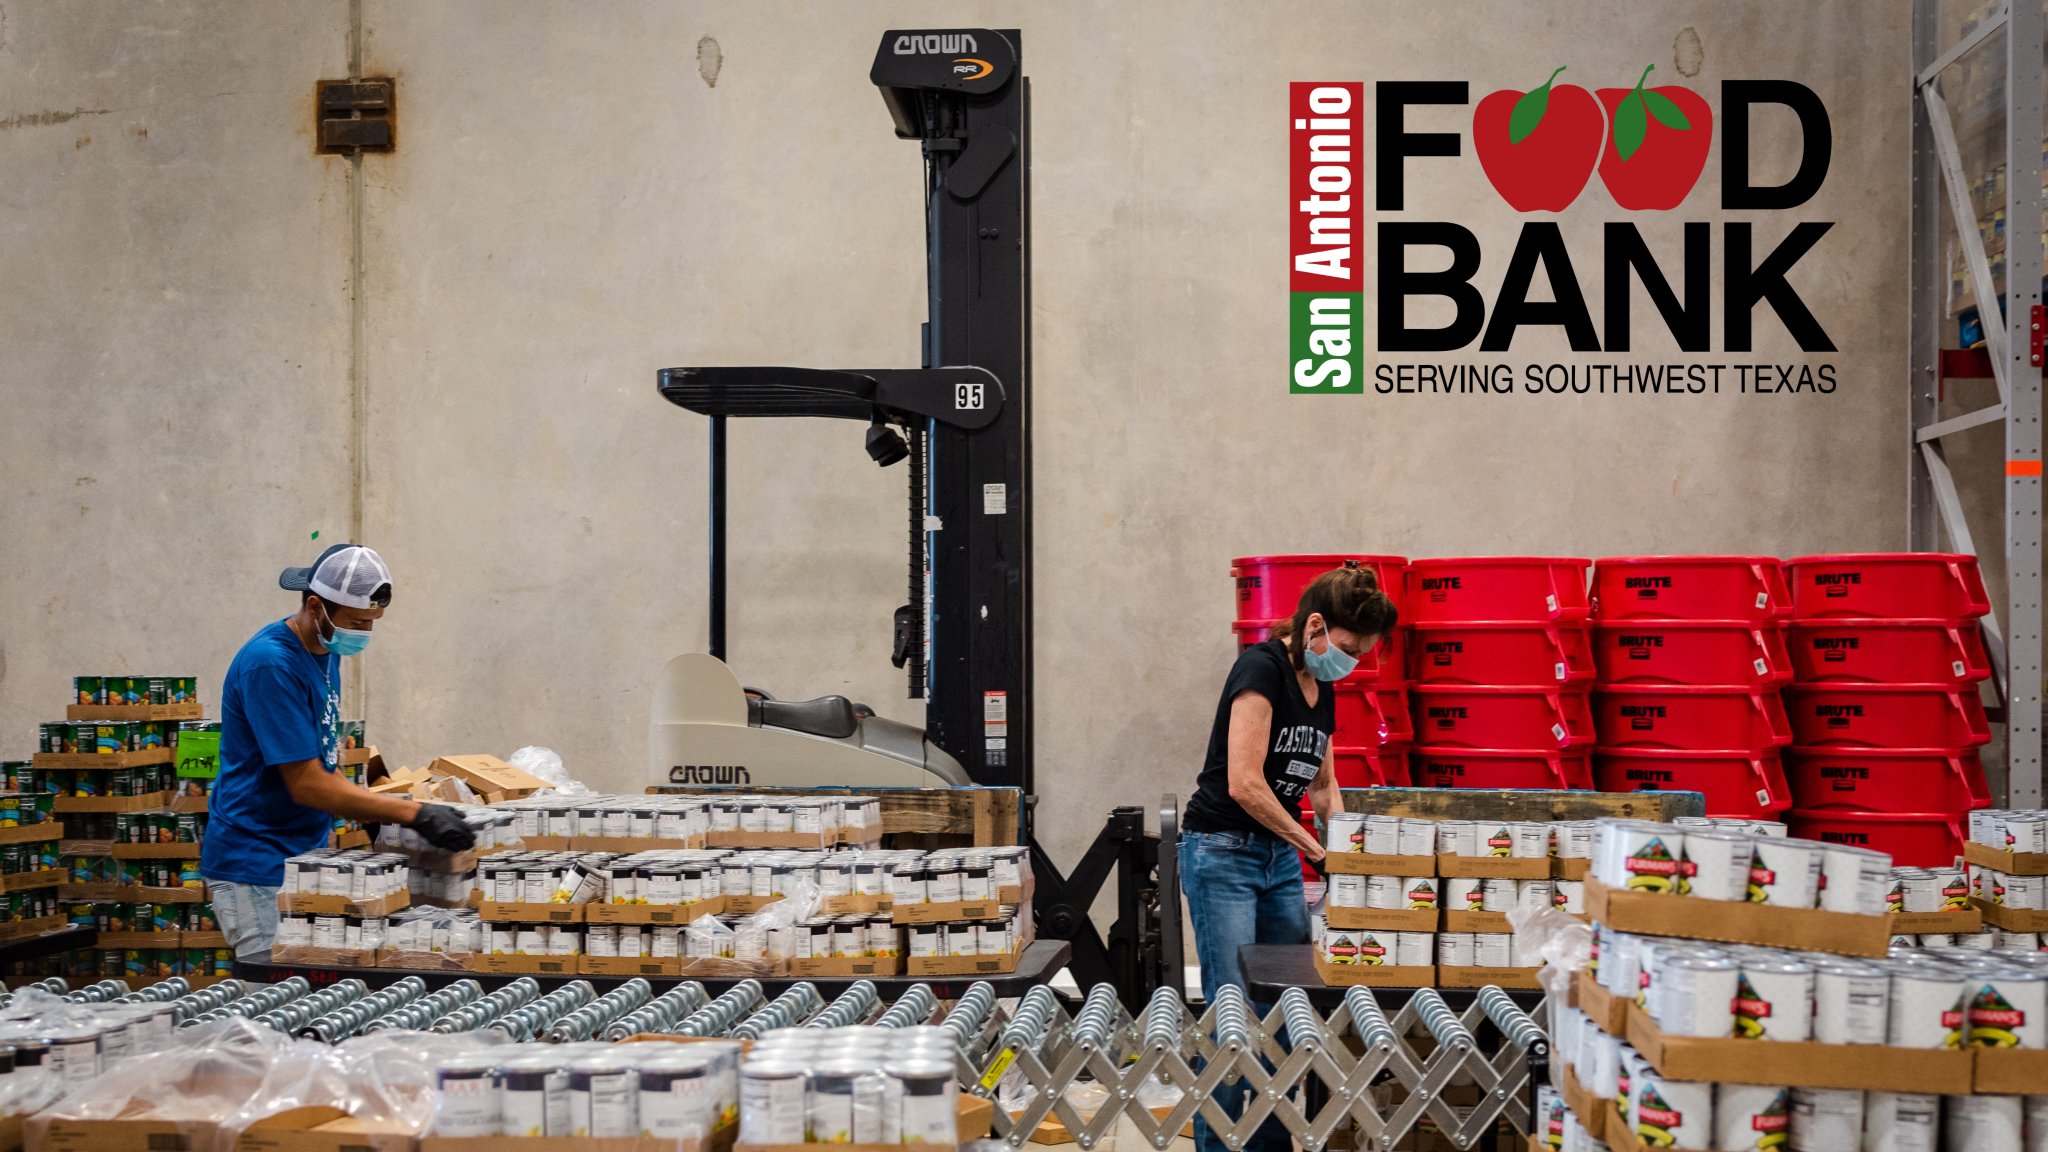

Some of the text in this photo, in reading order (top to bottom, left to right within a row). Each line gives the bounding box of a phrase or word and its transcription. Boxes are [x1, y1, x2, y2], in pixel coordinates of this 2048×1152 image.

[894, 34, 977, 55] CROWN
[953, 65, 978, 74] RR
[1422, 577, 1461, 590] BRUTE
[1625, 576, 1672, 589] BRUTE
[1814, 572, 1861, 586] BRUTE
[1426, 641, 1464, 654] BRUTE
[1618, 635, 1664, 648] BRUTE
[1813, 637, 1860, 650] BRUTE
[1428, 706, 1467, 719] BRUTE
[1620, 705, 1668, 718] BRUTE
[1815, 704, 1865, 717] BRUTE
[669, 765, 751, 784] CROWN
[1427, 763, 1465, 776] BRUTE
[1625, 768, 1674, 782] BRUTE
[1820, 766, 1870, 780] BRUTE
[1820, 832, 1869, 845] BRUTE
